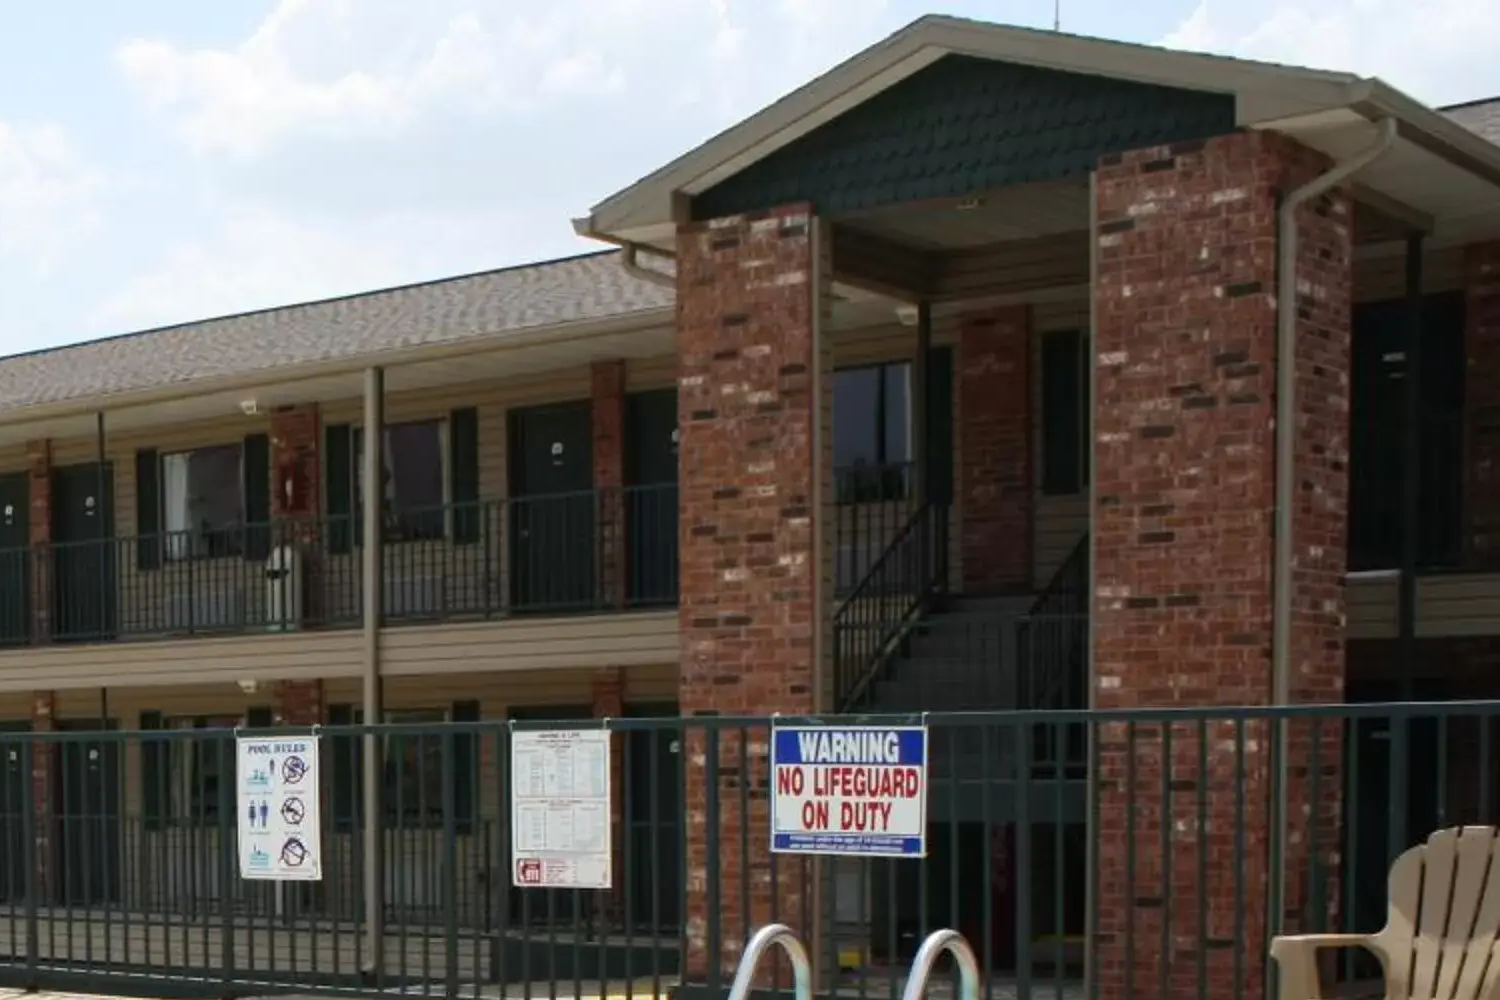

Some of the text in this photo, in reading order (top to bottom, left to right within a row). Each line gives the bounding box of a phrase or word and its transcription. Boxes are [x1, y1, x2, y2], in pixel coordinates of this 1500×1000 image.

[797, 732, 900, 763] WARNING
[778, 767, 918, 798] NO LIFEGUARD
[802, 801, 893, 831] ON DUTY
